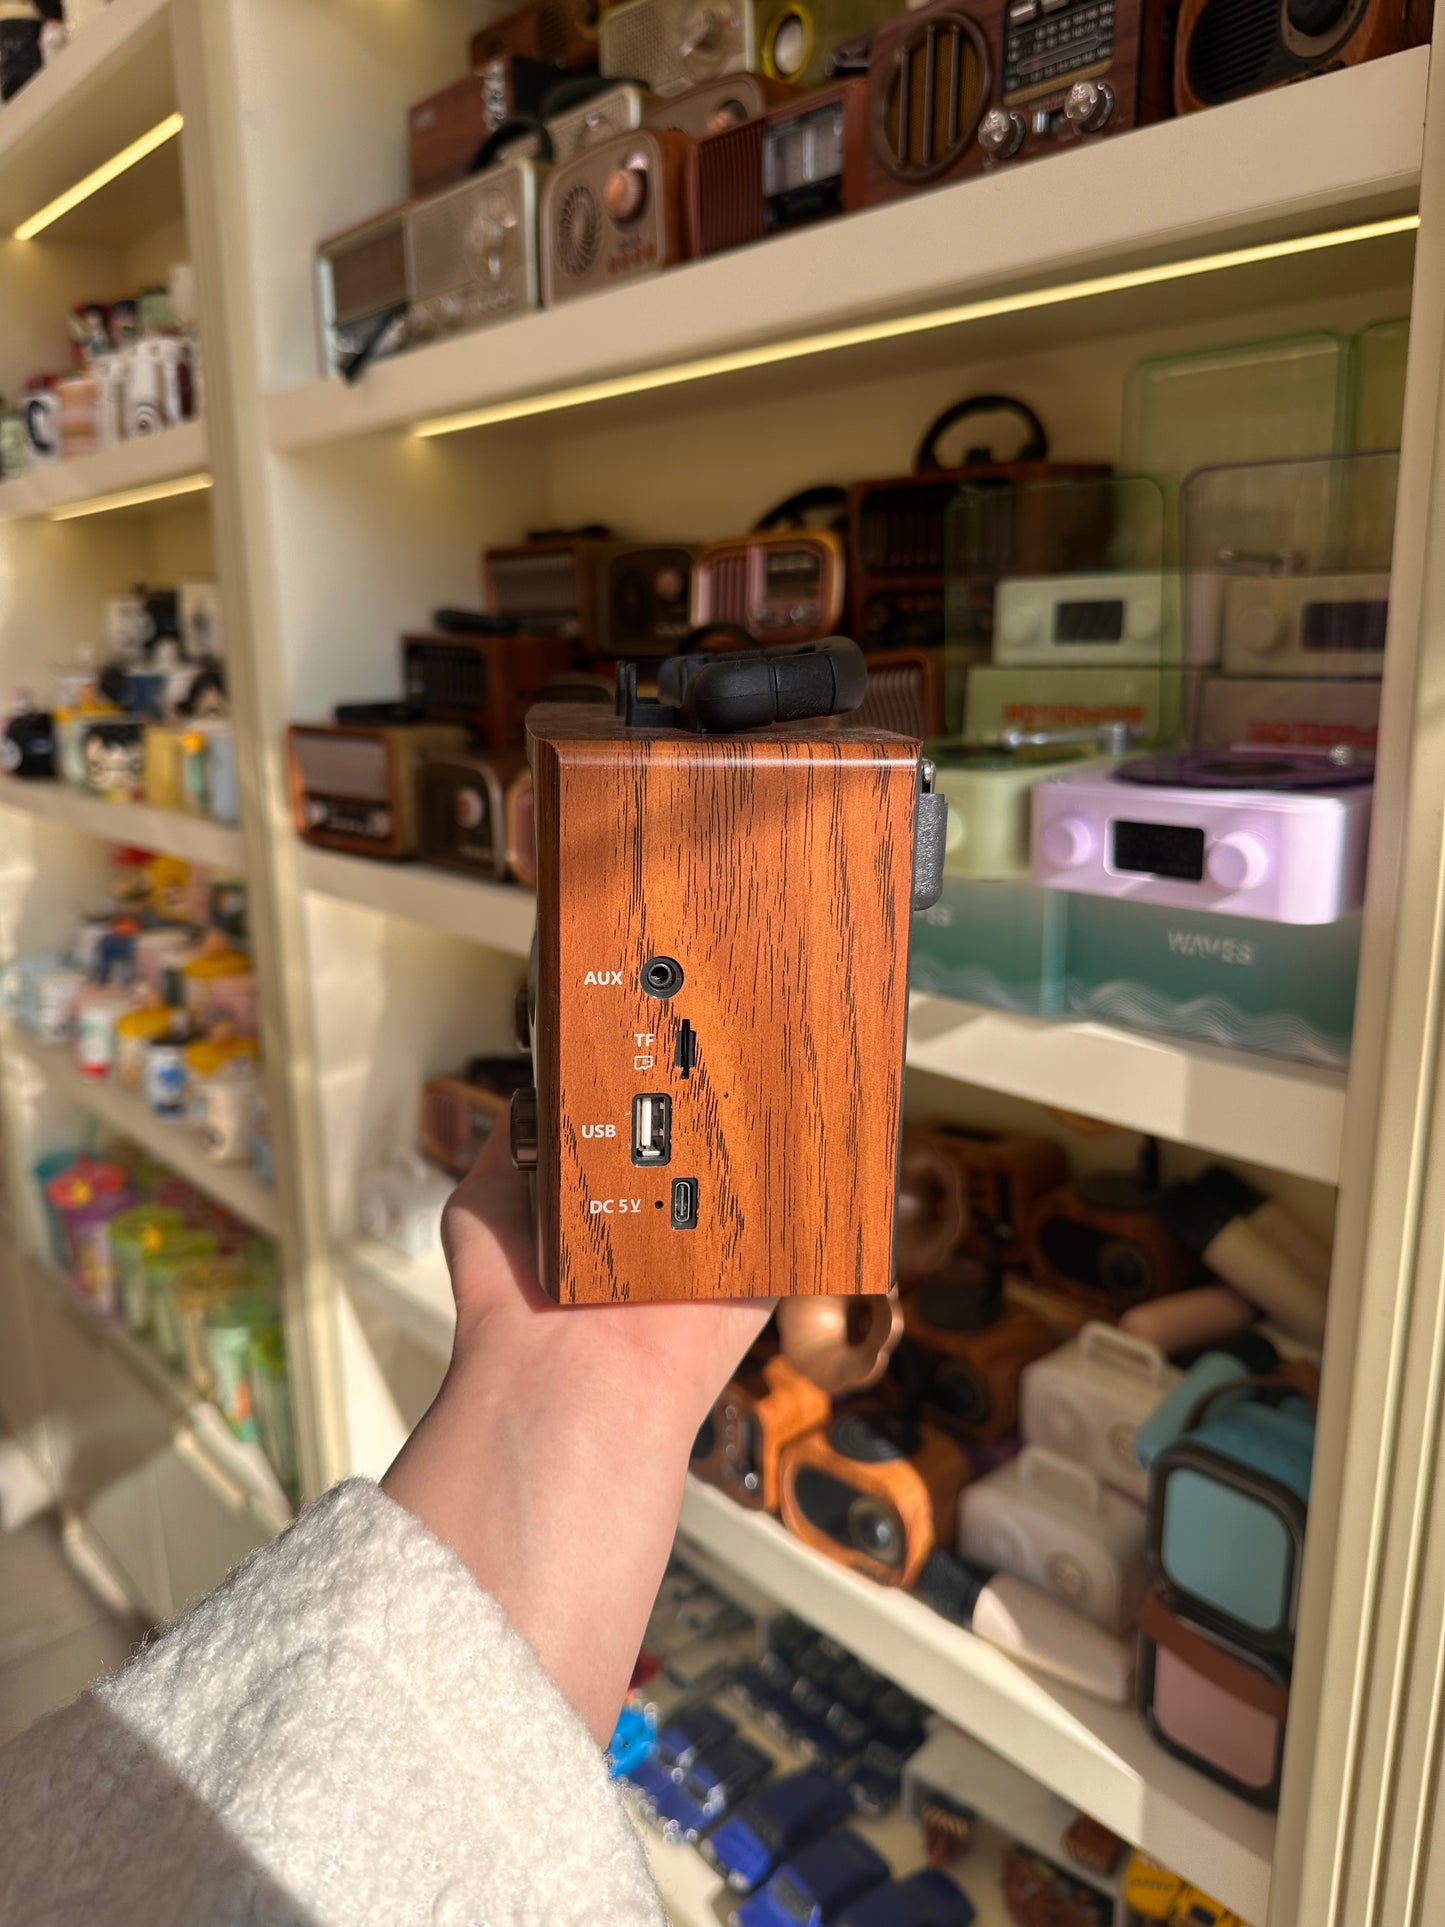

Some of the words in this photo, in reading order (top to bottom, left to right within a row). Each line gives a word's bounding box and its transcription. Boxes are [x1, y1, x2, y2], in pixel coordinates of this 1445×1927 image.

[1166, 928, 1253, 965] WAVES
[583, 970, 623, 986] AUX
[633, 1033, 655, 1047] TF
[581, 1124, 617, 1139] USB
[589, 1198, 614, 1214] DC
[618, 1198, 642, 1213] 5V
